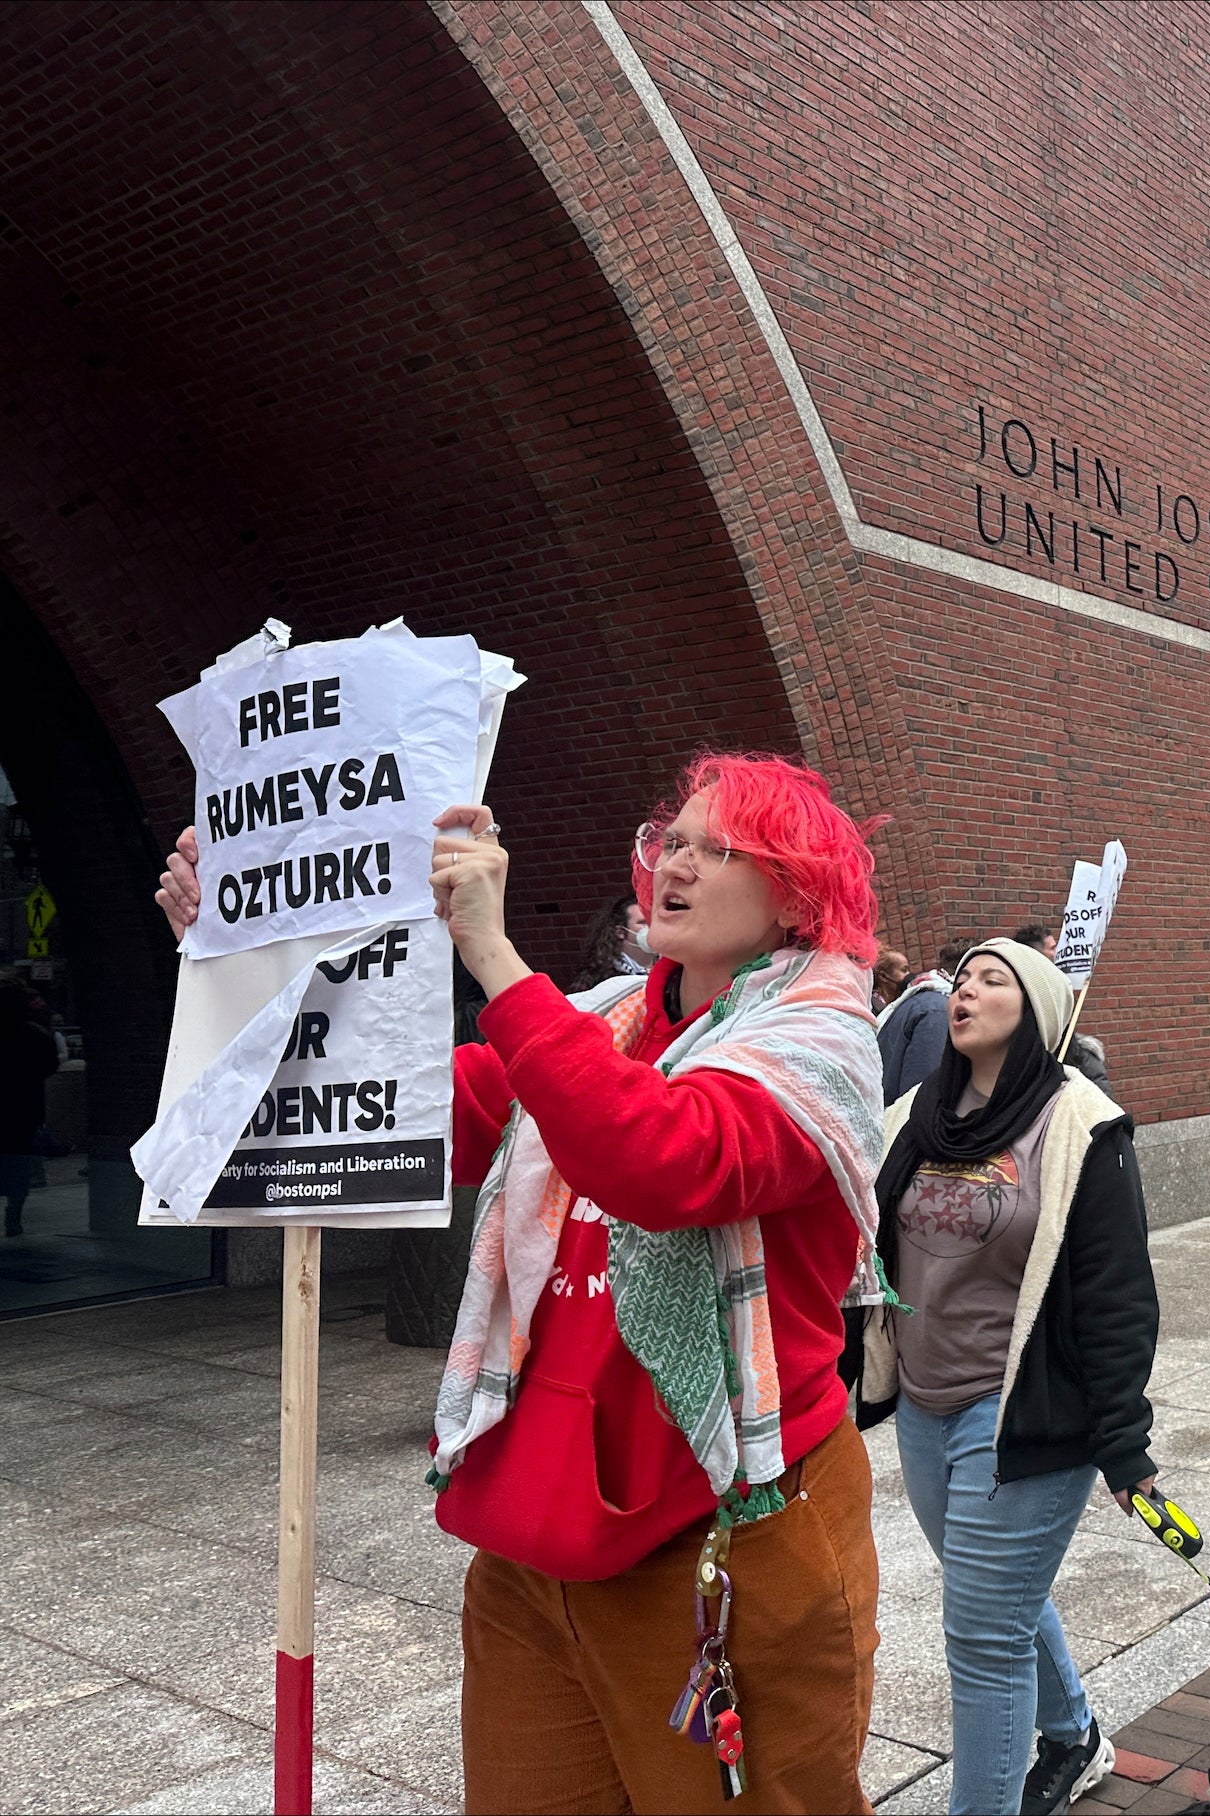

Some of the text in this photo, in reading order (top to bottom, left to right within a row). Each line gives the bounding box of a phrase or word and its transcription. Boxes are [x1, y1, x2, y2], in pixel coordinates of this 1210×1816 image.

[975, 405, 1122, 516] JOHN
[976, 484, 1179, 601] UNITED
[238, 676, 341, 748] FREE
[206, 752, 405, 844] RUMEYSA
[217, 842, 392, 925] OZTURK!
[240, 1079, 398, 1139] DENTS!
[222, 1153, 425, 1180] arty for Socialism and Liberation
[265, 1180, 342, 1201] @bostonpsl
